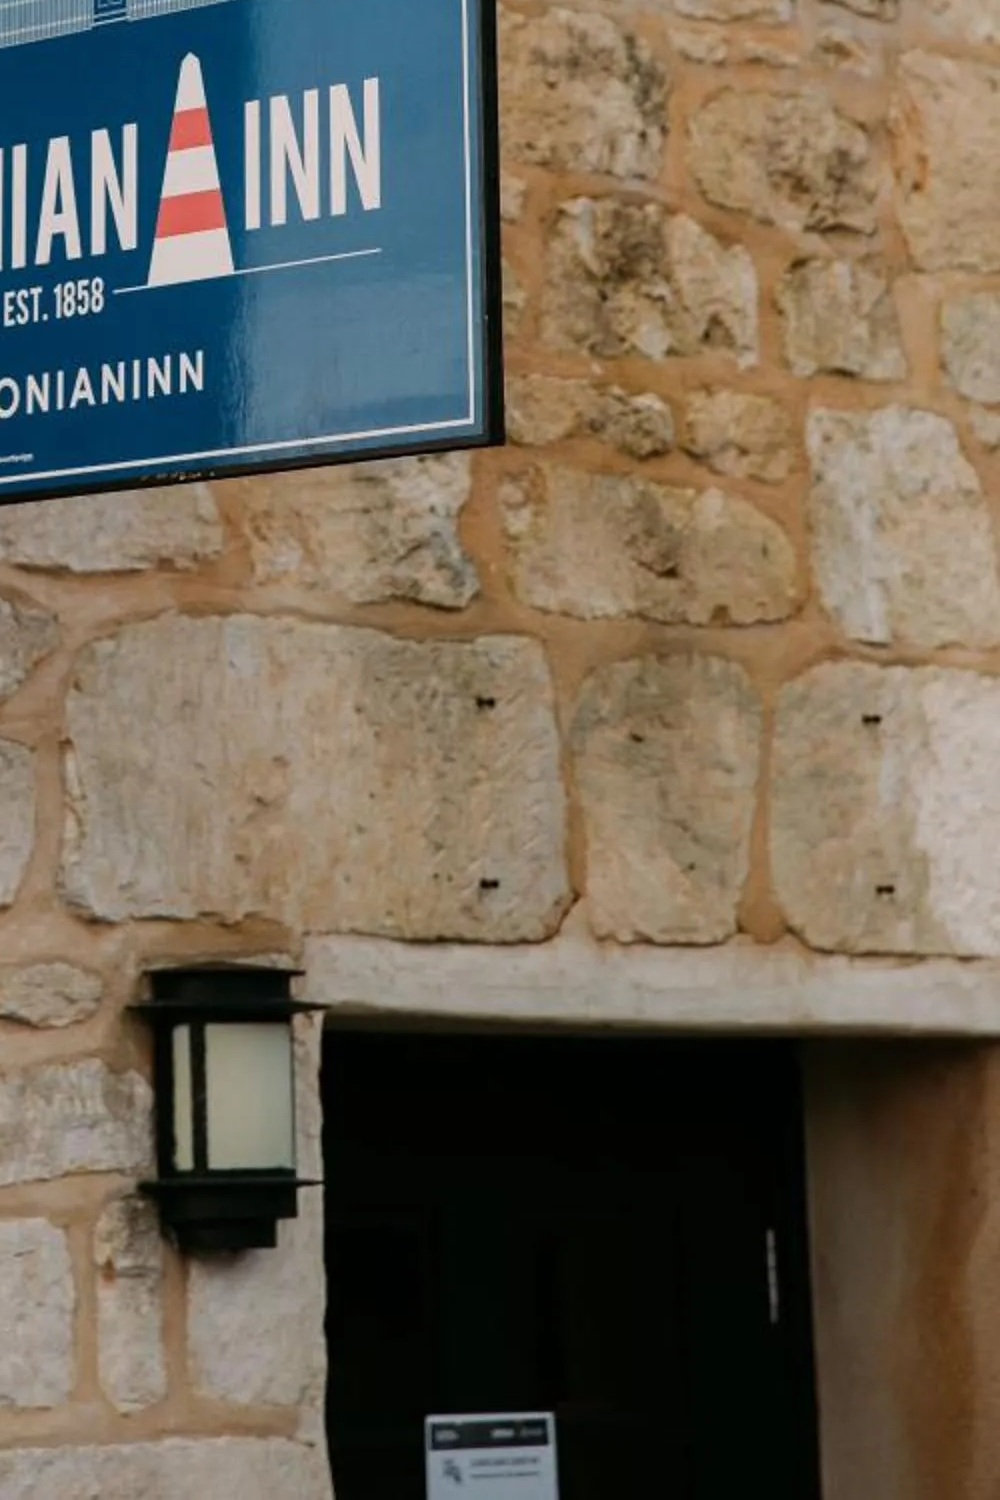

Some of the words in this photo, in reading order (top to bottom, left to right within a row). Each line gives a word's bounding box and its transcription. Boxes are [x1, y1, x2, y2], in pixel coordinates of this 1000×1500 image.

[243, 76, 382, 232] INN
[3, 285, 49, 327] EST.
[53, 276, 105, 319] 1858
